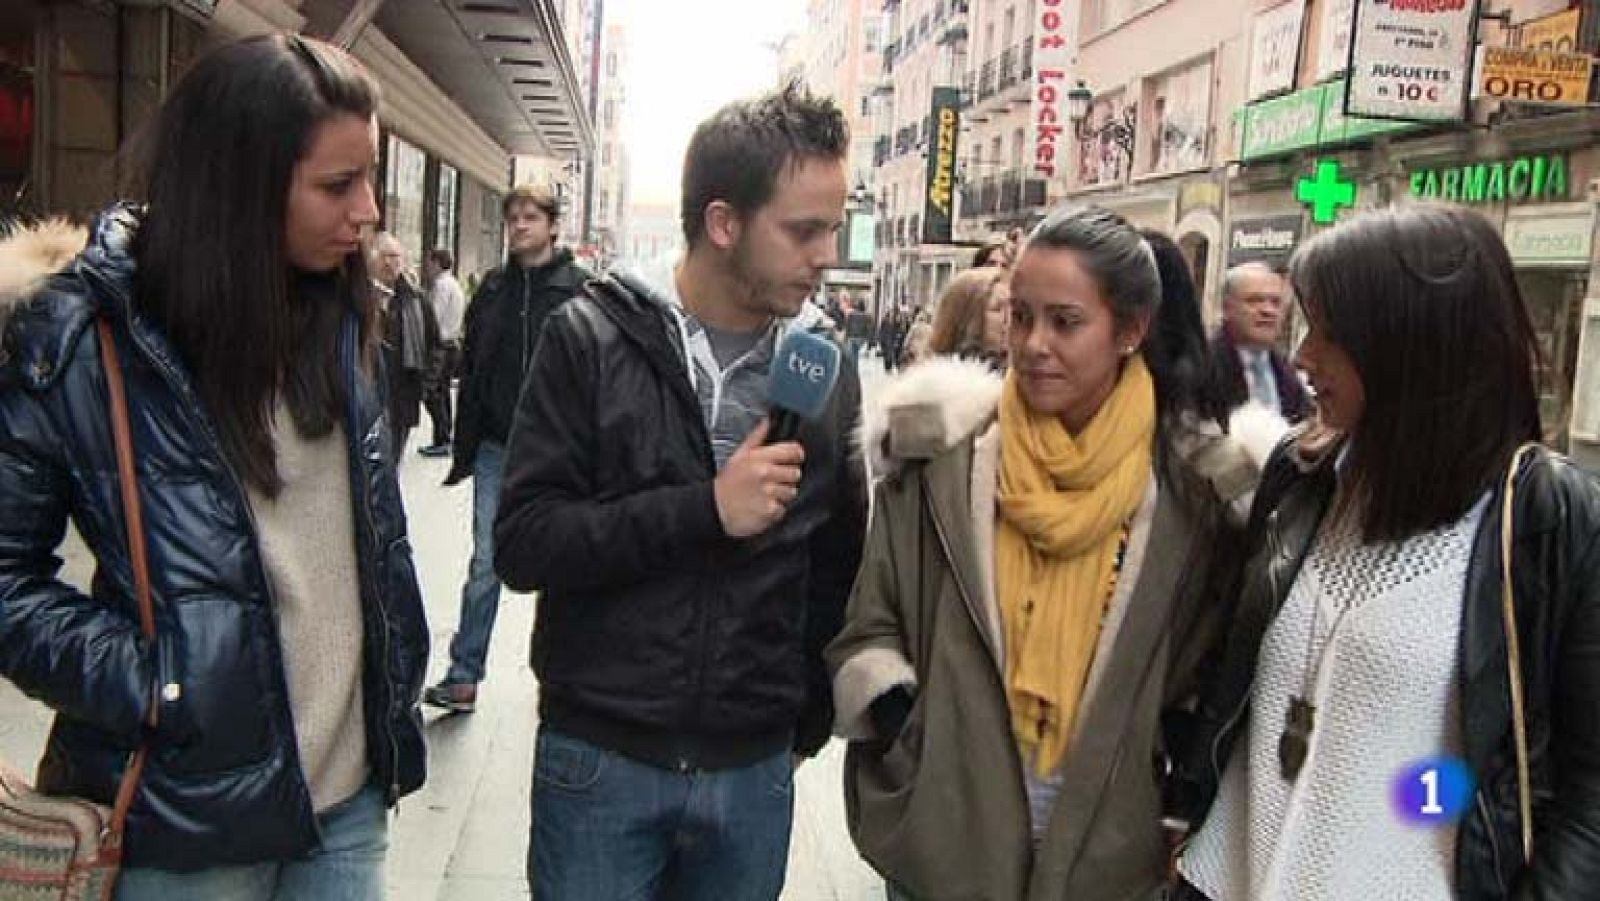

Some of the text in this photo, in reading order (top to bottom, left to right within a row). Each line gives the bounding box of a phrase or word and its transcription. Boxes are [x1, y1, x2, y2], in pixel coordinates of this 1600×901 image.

[1371, 64, 1451, 80] JUGUETES
[1397, 82, 1421, 101] 10
[1485, 76, 1563, 100] ORO
[1035, 70, 1065, 178] Locker
[1409, 155, 1567, 201] FARMACIA
[789, 351, 825, 382] tve
